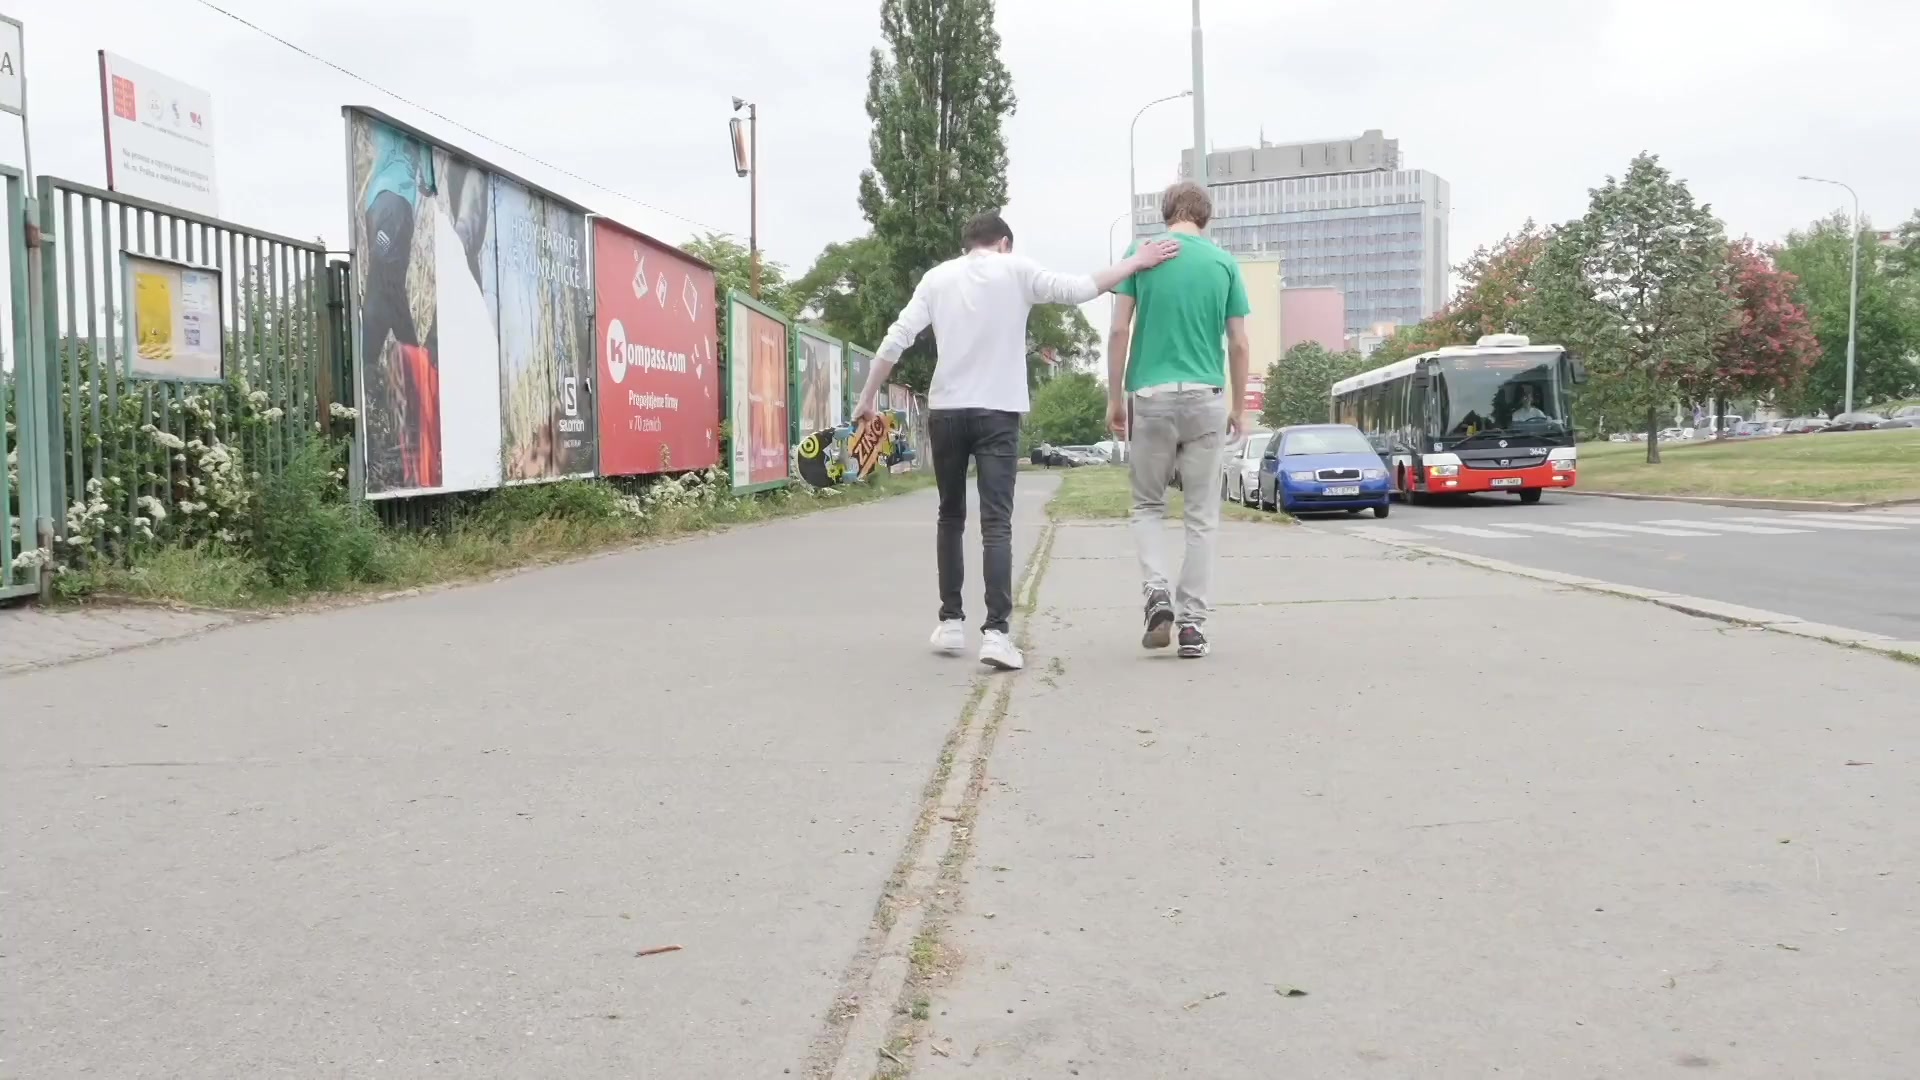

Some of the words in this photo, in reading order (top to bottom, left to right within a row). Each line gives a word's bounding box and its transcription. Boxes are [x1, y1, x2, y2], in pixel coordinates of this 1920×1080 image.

[511, 216, 539, 245] HRDÝ
[542, 227, 579, 260] PARTNER
[664, 393, 679, 412] firmy
[634, 415, 642, 432] 70
[1529, 447, 1548, 457] 3642
